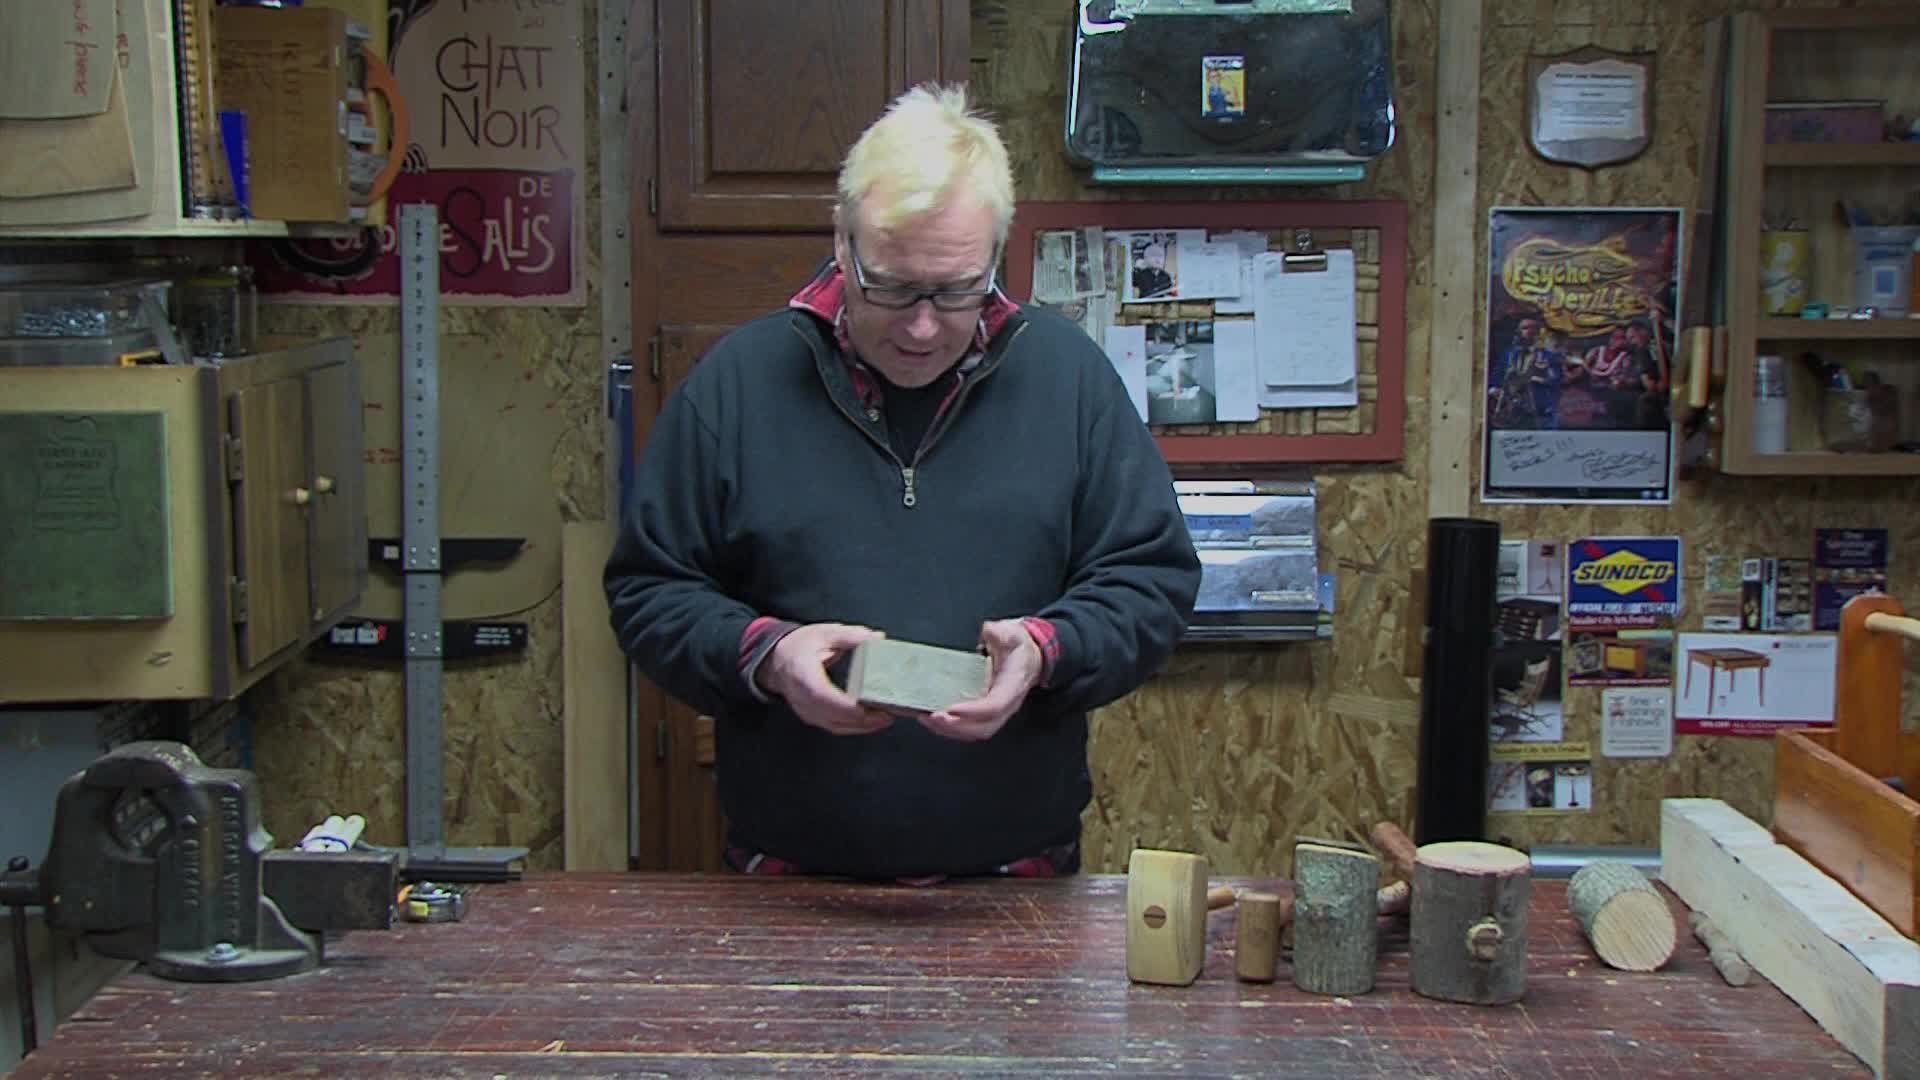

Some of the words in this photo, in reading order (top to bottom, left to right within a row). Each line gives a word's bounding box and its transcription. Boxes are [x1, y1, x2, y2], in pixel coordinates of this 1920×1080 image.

[436, 32, 553, 110] CHAT
[441, 92, 568, 159] NOIR
[518, 177, 553, 198] DE
[1579, 563, 1669, 580] SUNOCO
